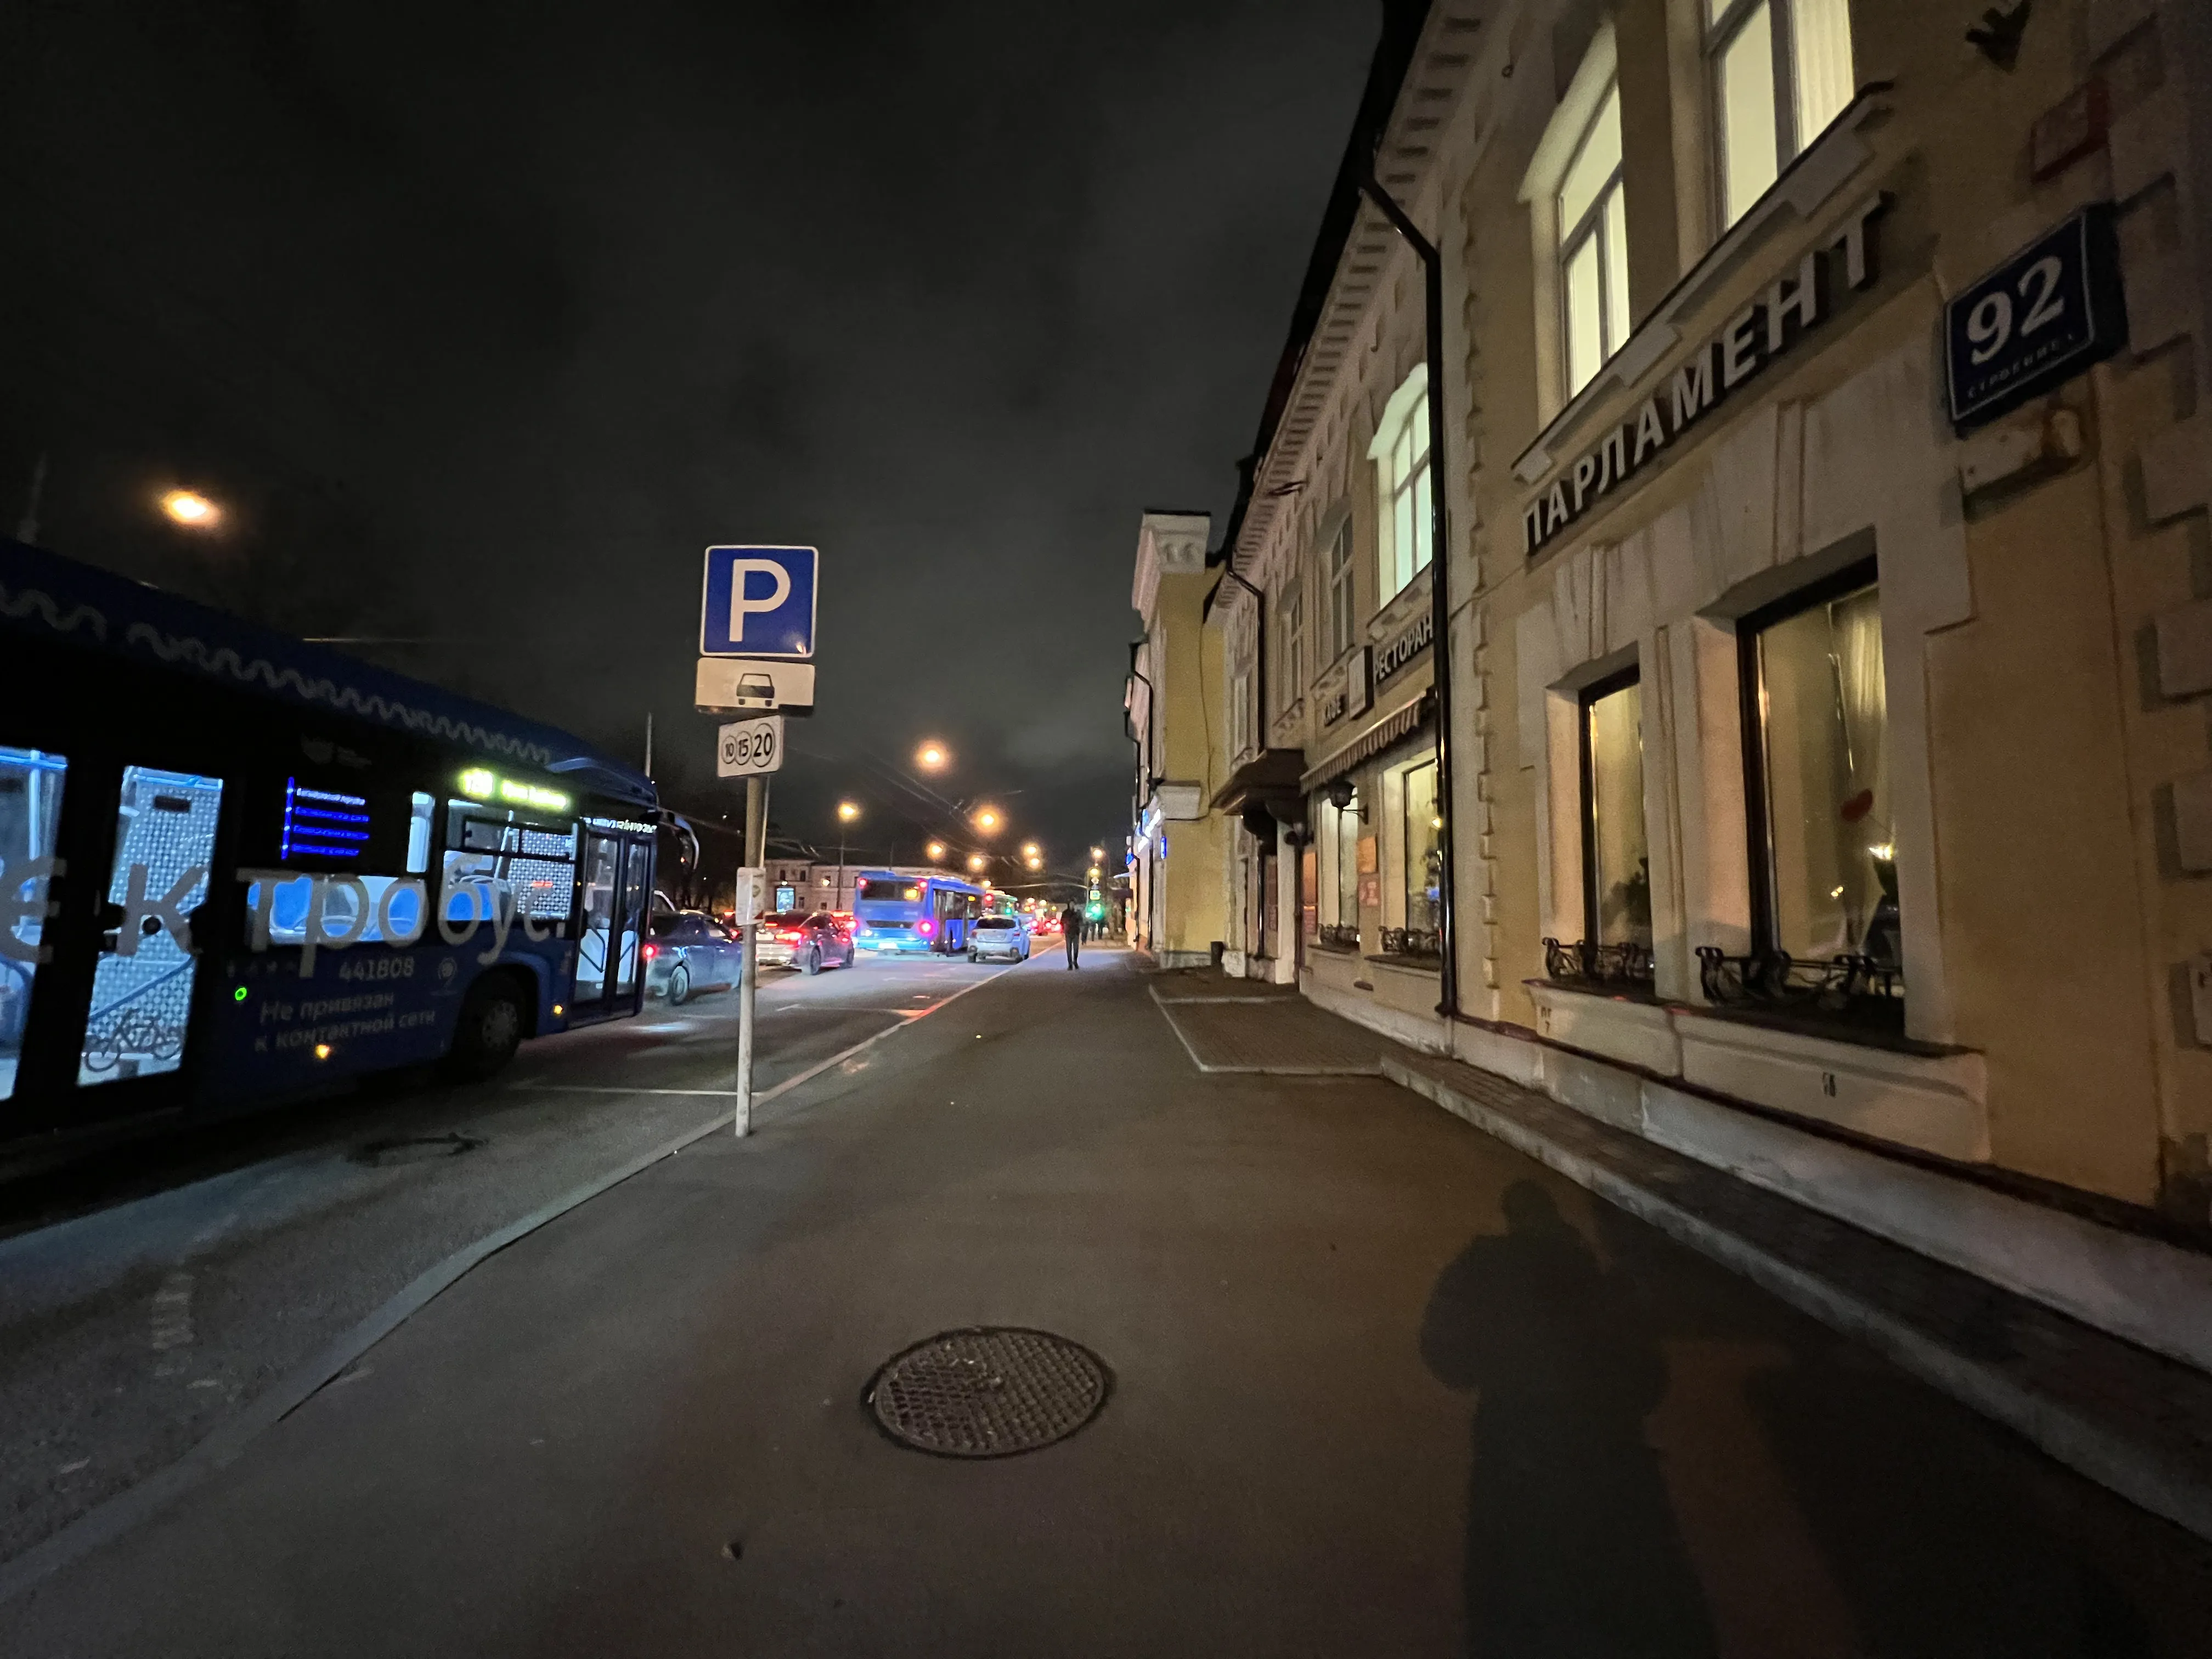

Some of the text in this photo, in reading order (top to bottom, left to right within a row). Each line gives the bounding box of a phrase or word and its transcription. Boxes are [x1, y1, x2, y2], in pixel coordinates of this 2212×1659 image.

[1967, 255, 2065, 365] 92
[1521, 192, 1887, 554] ПАРЛАМЕНТ
[729, 558, 791, 642] P
[1373, 613, 1434, 686] РЕСТОРАН
[725, 732, 772, 758] 10 15 20
[259, 1000, 294, 1025] Не
